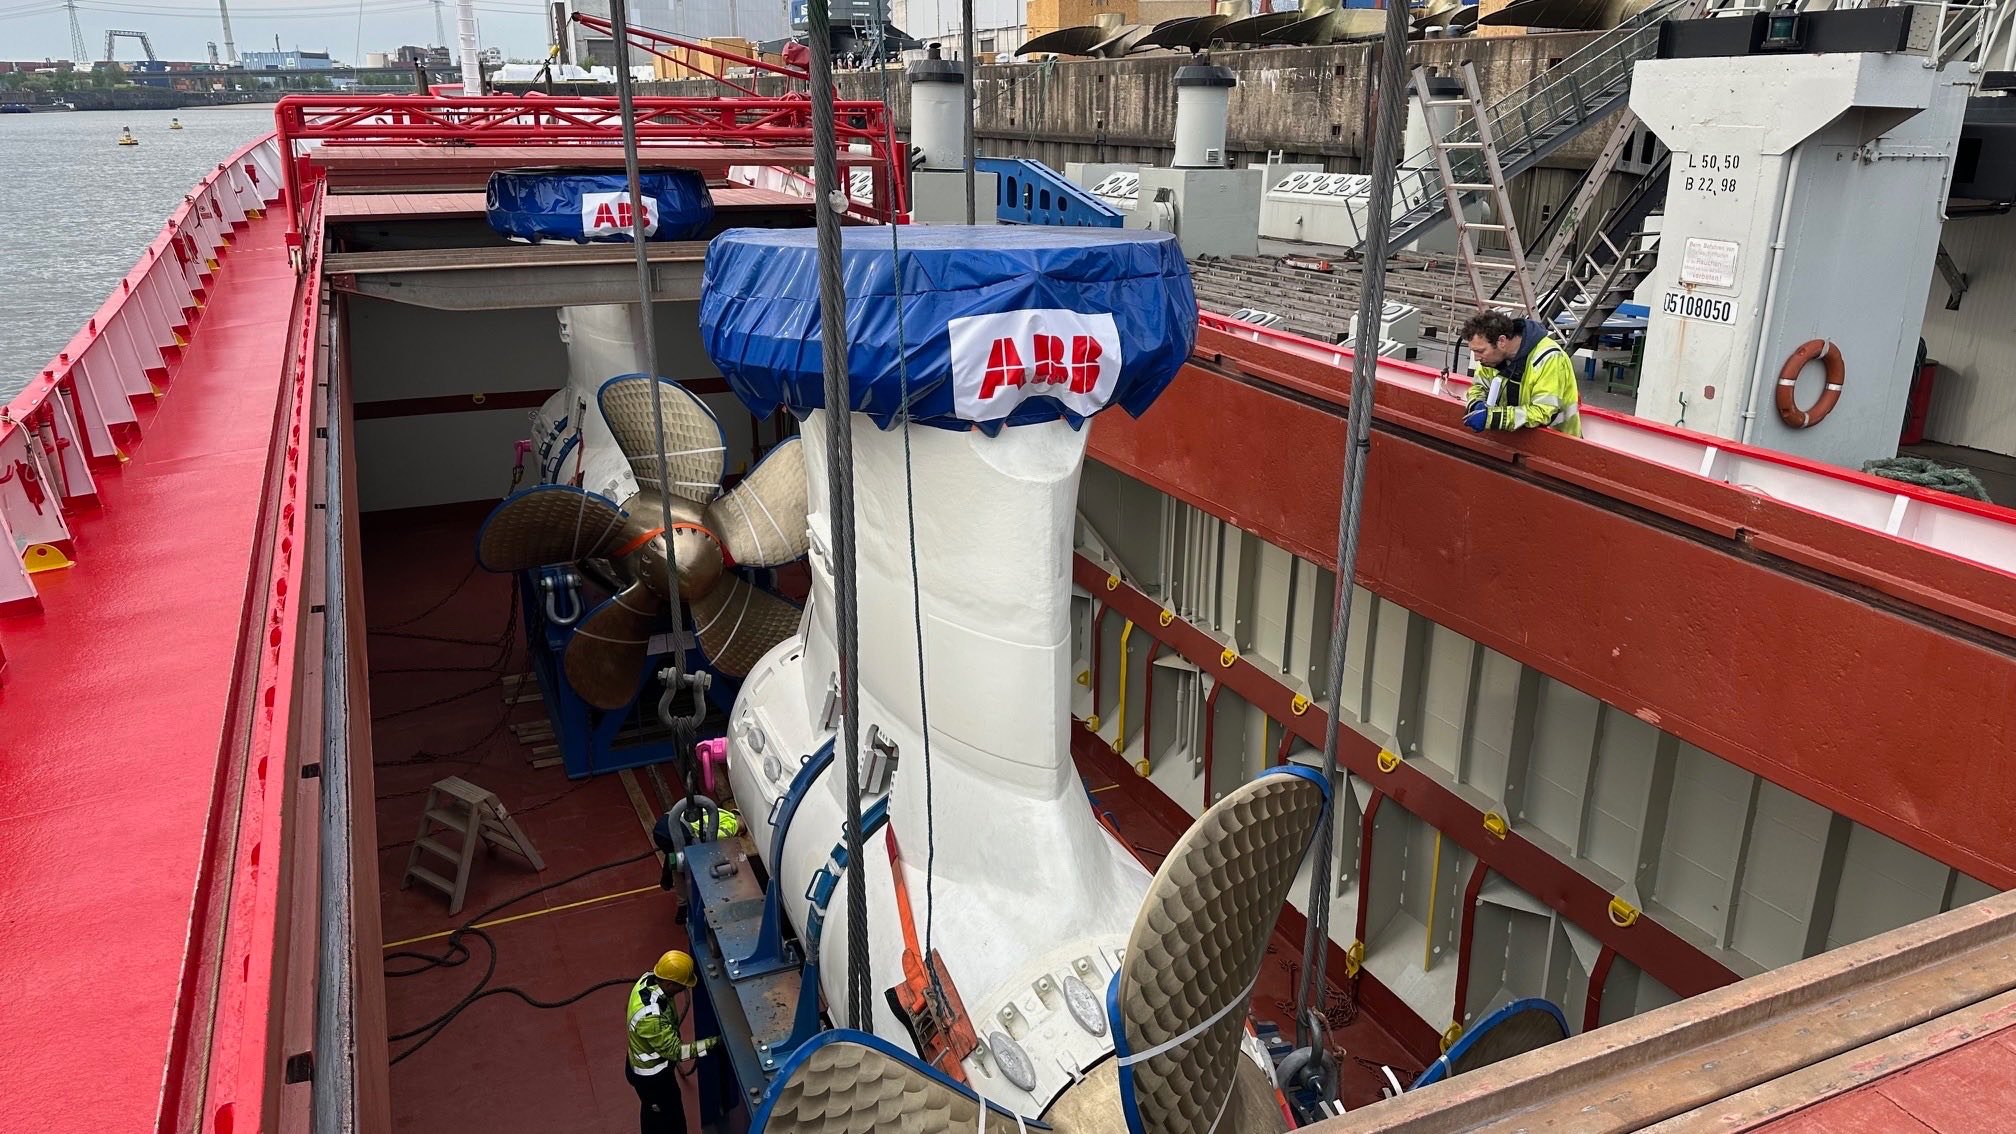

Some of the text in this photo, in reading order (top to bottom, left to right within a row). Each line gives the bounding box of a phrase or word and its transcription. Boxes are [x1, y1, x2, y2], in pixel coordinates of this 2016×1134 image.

[1689, 154, 1696, 168] L
[1685, 177, 1694, 190] B
[1664, 293, 1731, 321] 05108050
[978, 333, 1103, 400] ABB
